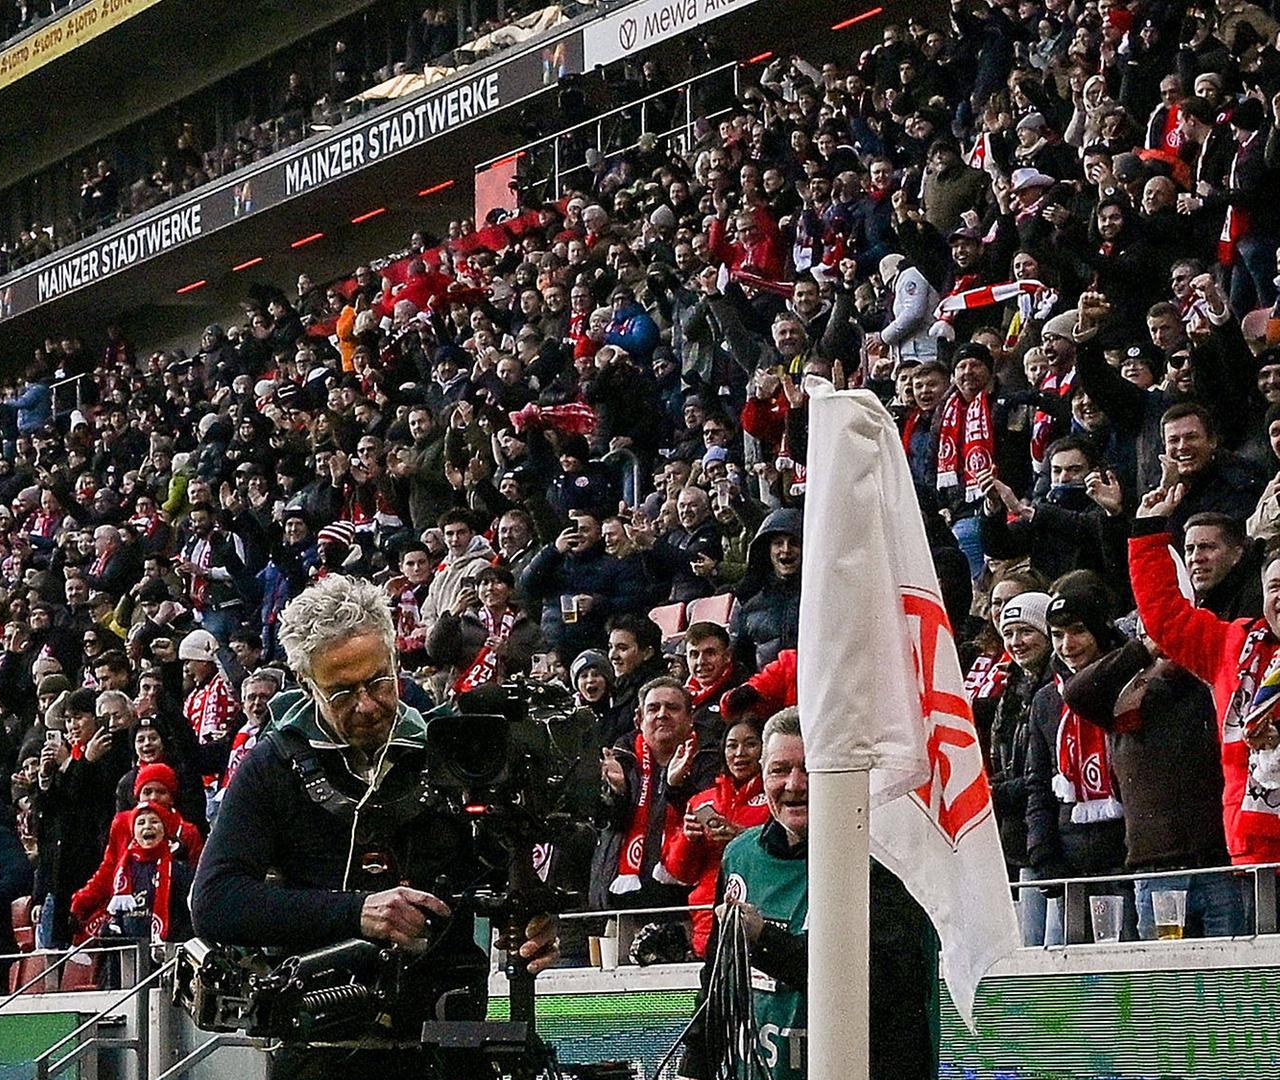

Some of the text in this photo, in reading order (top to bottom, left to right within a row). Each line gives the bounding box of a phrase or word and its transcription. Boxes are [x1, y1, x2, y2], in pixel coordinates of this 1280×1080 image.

[285, 73, 500, 195] MAINZER STADTWERKE
[38, 204, 202, 302] MAINZER STADTWERKE
